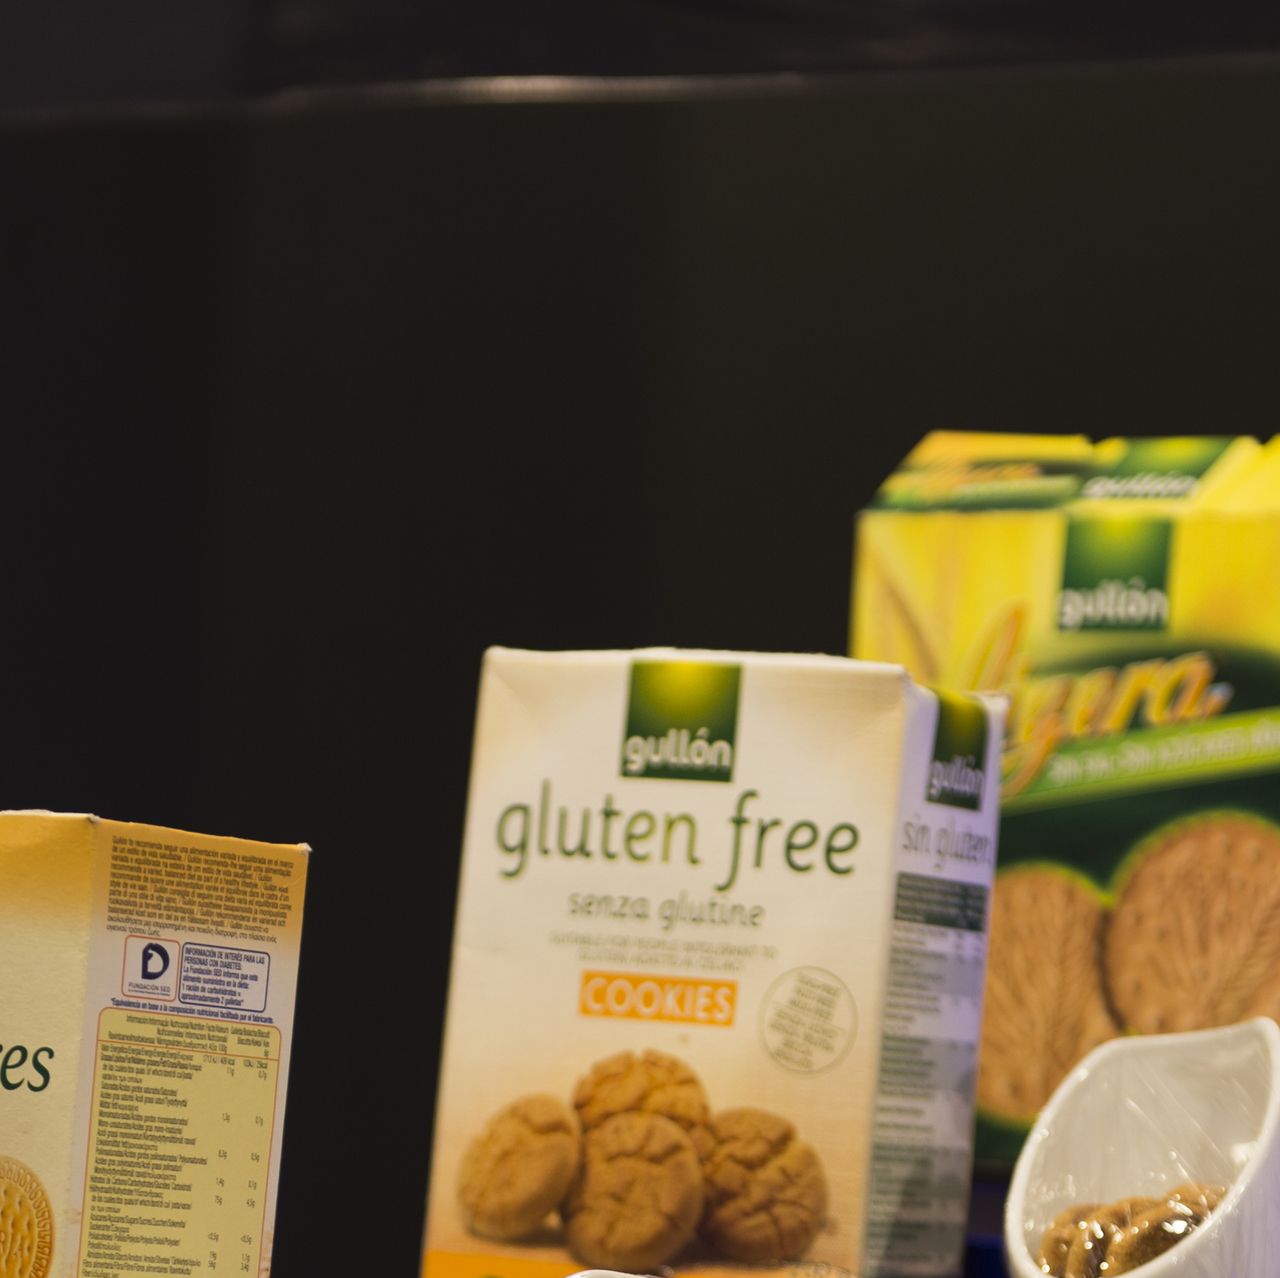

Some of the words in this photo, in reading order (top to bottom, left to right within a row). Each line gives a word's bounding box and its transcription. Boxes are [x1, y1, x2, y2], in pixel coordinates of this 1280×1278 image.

[1059, 577, 1167, 629] gullón
[626, 727, 732, 774] gullón
[929, 755, 985, 799] gullón
[496, 779, 702, 880] gluten
[716, 790, 860, 894] free
[567, 893, 650, 921] senza
[658, 889, 767, 932] glutine
[584, 977, 732, 1023] COOKIES
